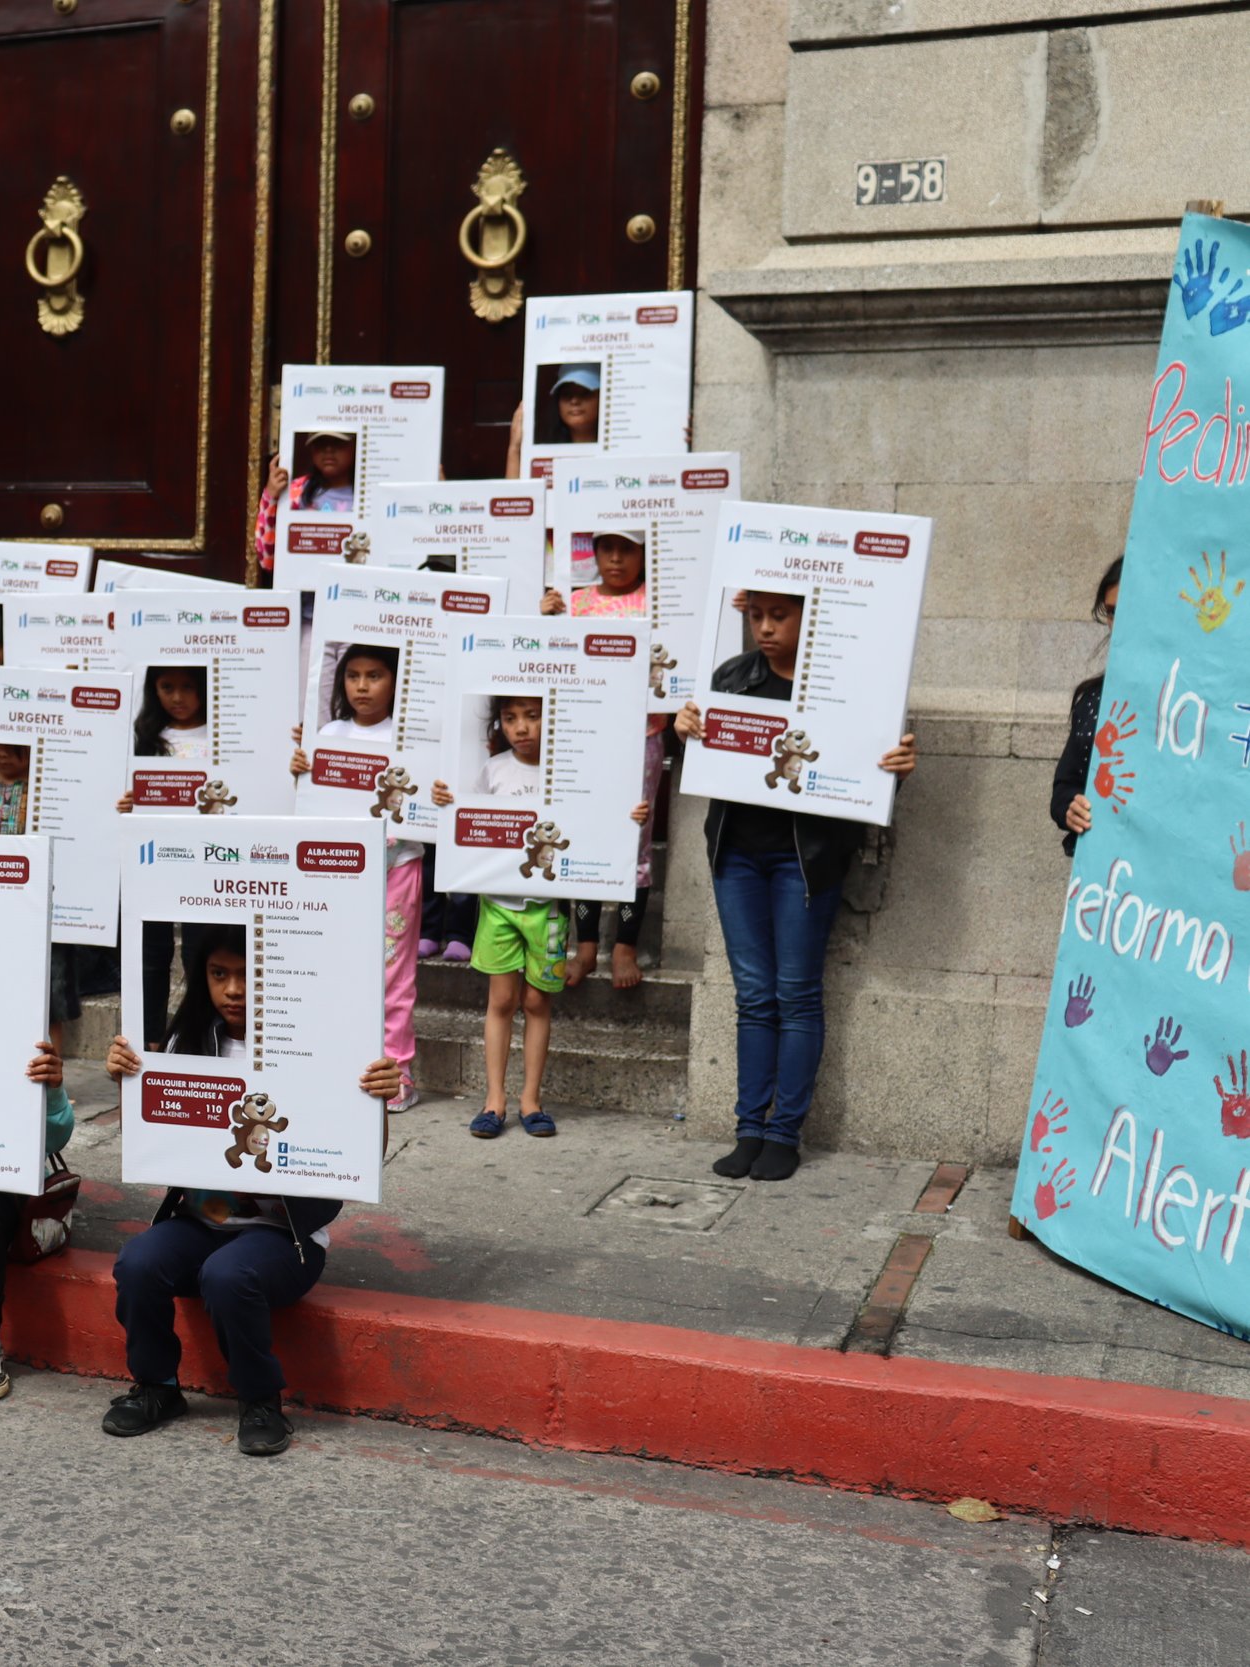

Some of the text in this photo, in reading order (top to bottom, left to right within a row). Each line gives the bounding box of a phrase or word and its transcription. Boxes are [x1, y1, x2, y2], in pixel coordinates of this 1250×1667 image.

[858, 161, 943, 204] 9-58
[582, 332, 629, 343] URGENTE
[338, 405, 384, 414] URGENTE
[622, 497, 675, 510] URGENTE
[435, 524, 484, 535] URGENTE
[783, 557, 844, 574] URGENTE
[2, 578, 39, 590] URGENTE
[379, 613, 433, 628] URGENTE
[60, 636, 104, 647] URGENTE
[184, 634, 236, 645] URGENTE
[512, 637, 540, 649] PGN
[518, 662, 576, 674] URGENTE
[2, 686, 30, 699] PGN
[1156, 657, 1209, 760] la
[8, 711, 64, 725] URGENTE
[15, 725, 33, 733] SER
[34, 726, 45, 734] TU
[48, 727, 67, 736] HIJO
[73, 729, 92, 737] HIJA
[204, 845, 239, 862] PGN
[250, 842, 278, 853] Alerta
[306, 847, 359, 857] ALBA-KENETH
[249, 851, 289, 861] Alba-Keneth
[303, 857, 357, 867] No. 0000-0000
[213, 879, 288, 896] URGENTE
[179, 895, 221, 907] PODRIA
[224, 897, 246, 908] SER
[249, 898, 264, 909] TU
[268, 899, 293, 910] HIJO
[302, 901, 328, 912] HIJA
[1061, 856, 1234, 984] reforma
[146, 1077, 241, 1092] CUALQUIER INFORMACIÓN
[163, 1086, 216, 1099] COMUNÍQUESE
[151, 1109, 189, 1118] ALBA-KENETH
[160, 1100, 222, 1114] 1546 110
[276, 1167, 360, 1182] www.albakeneth.gob.gt
